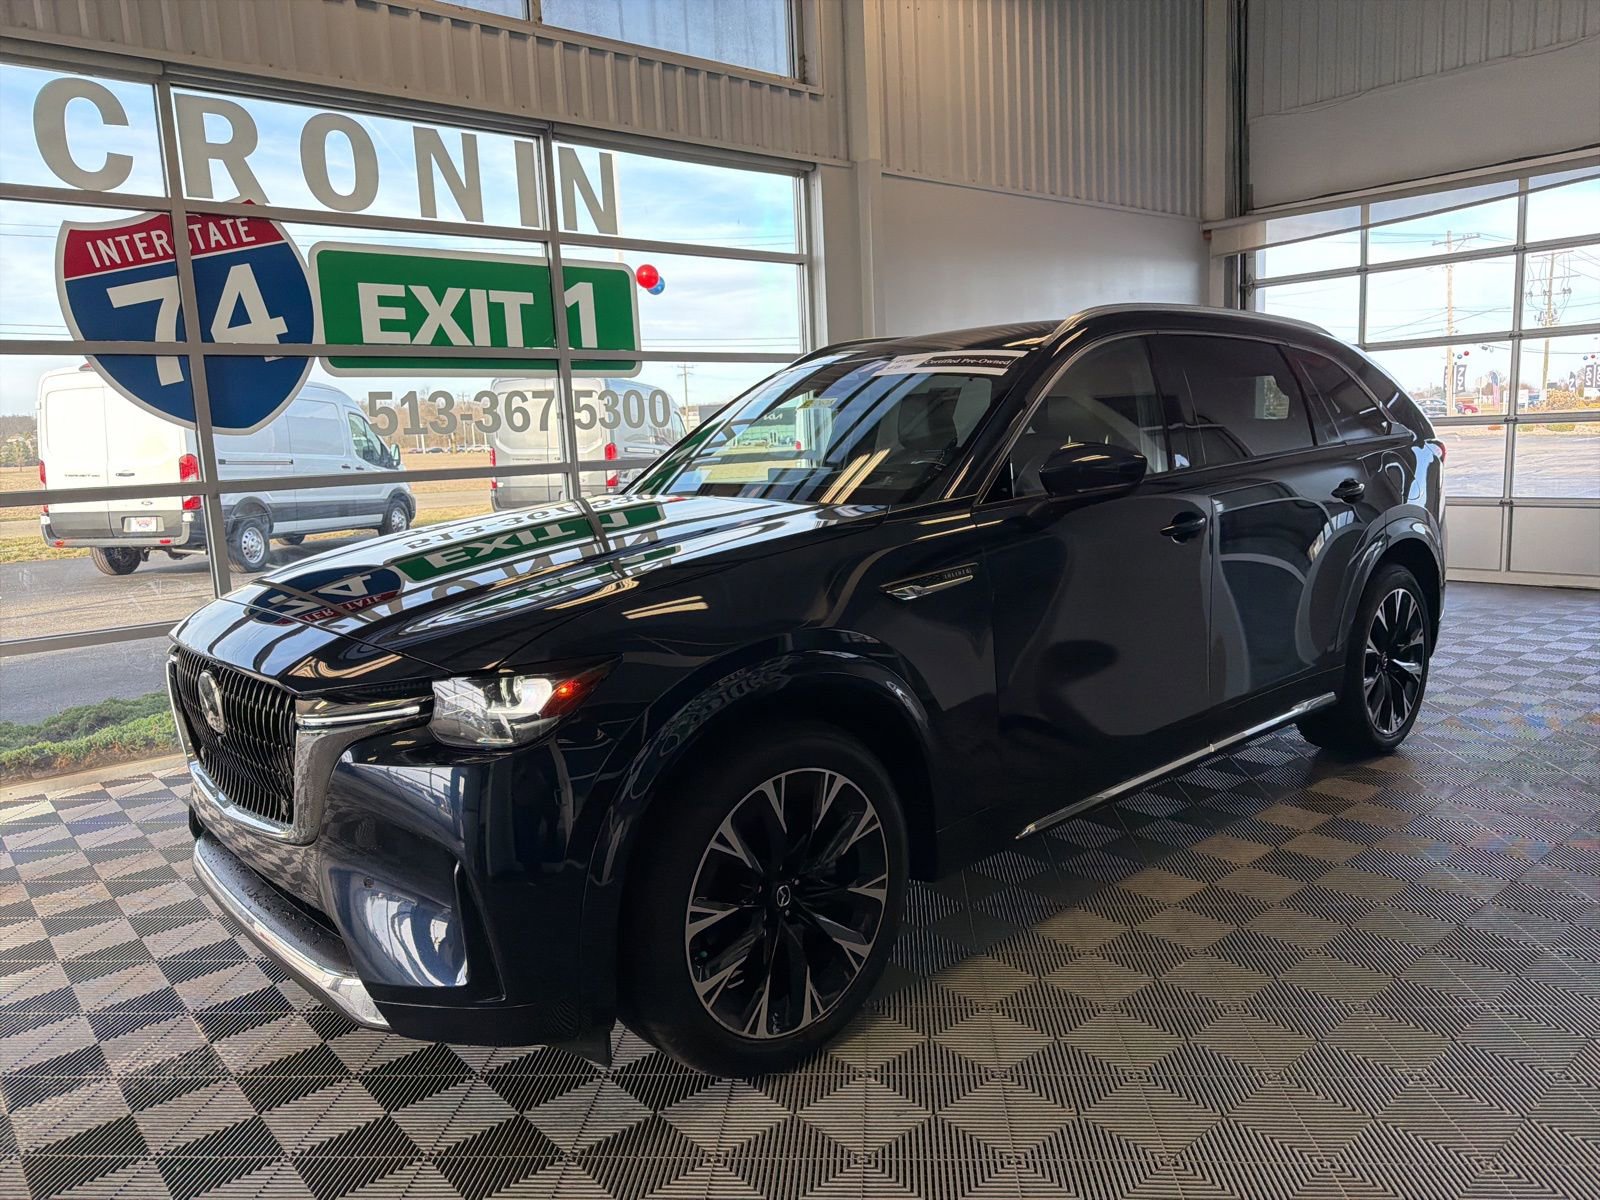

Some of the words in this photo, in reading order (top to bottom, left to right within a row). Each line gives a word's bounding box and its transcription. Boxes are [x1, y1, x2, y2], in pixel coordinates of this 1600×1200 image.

[33, 77, 618, 235] CRONIN
[86, 217, 256, 268] INTERTATE
[106, 262, 289, 387] 74
[357, 282, 535, 348] EXIT
[563, 281, 598, 348] 1
[925, 357, 959, 366] Certified
[961, 357, 1010, 366] Pre-Owned
[367, 388, 671, 436] 513-3675300
